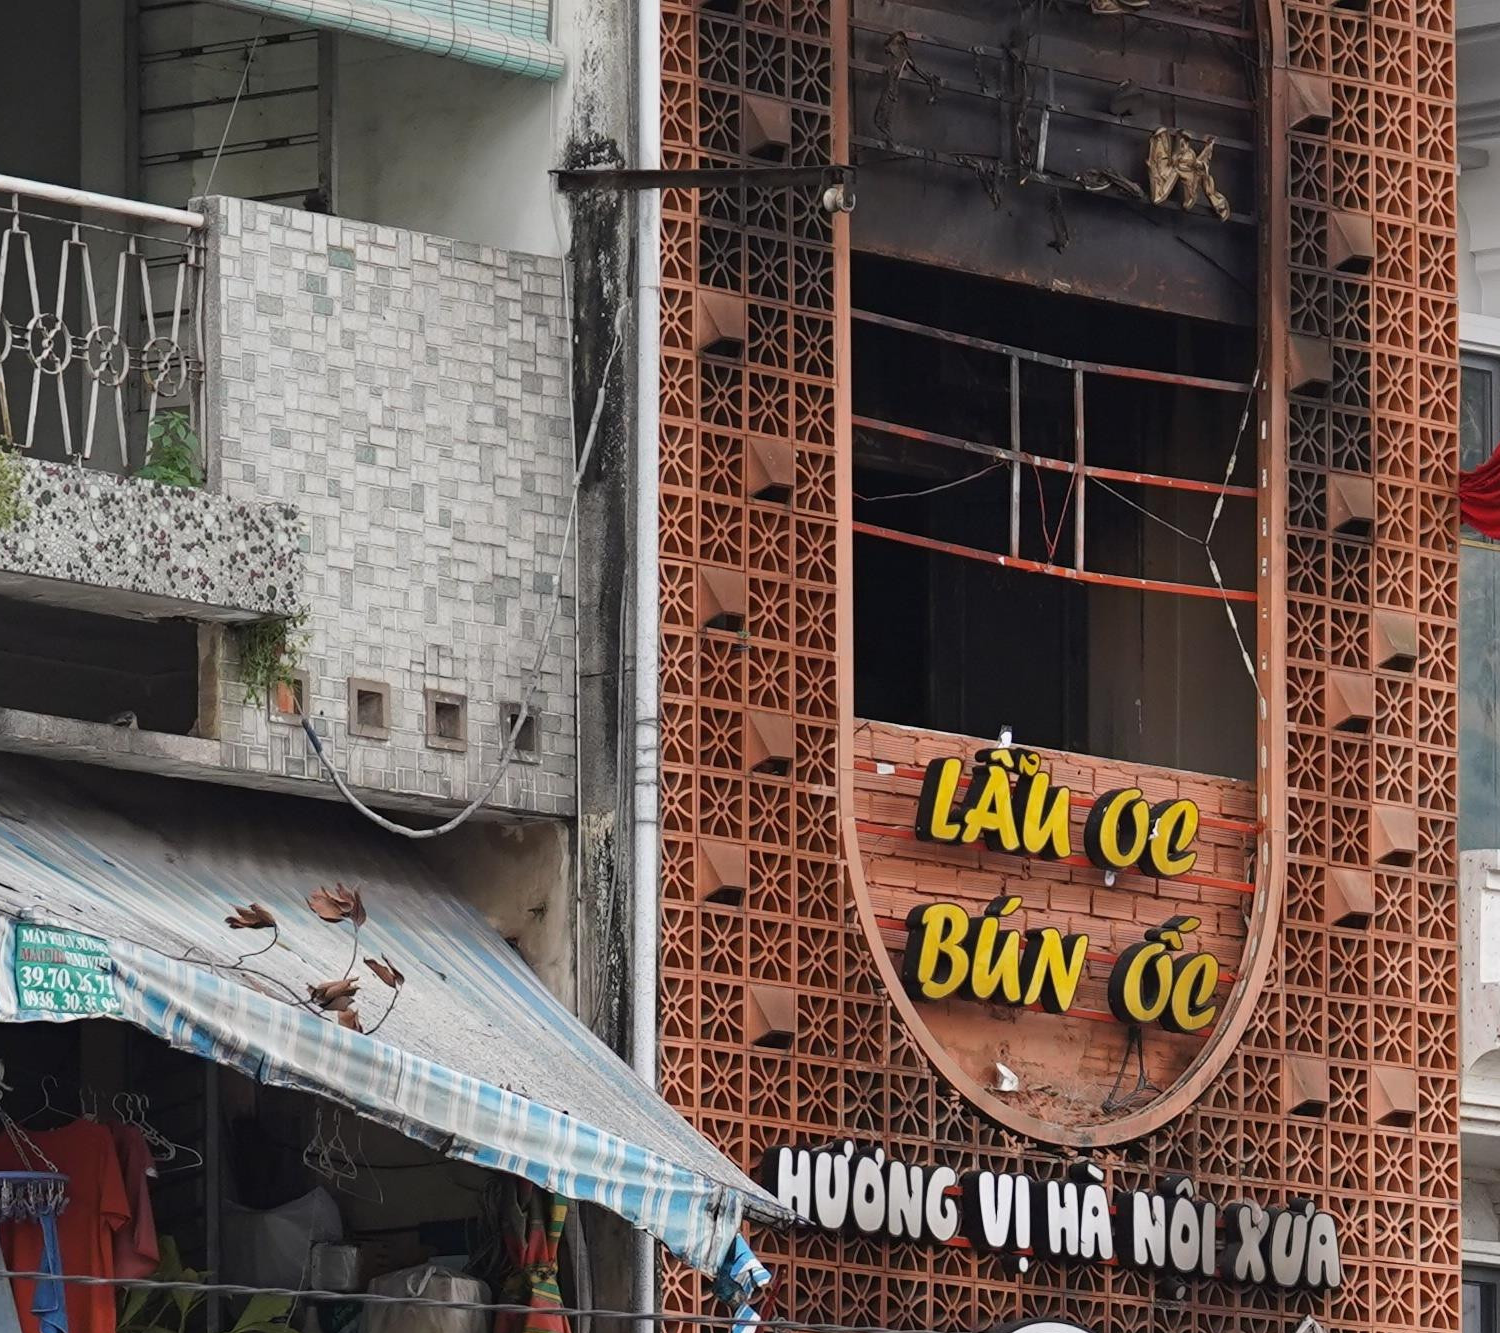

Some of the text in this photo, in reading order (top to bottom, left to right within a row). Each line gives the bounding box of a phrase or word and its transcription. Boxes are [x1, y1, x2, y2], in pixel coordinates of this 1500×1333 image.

[910, 896, 1218, 1032] BÚN ỐC
[774, 1140, 958, 1243] HƯƠNG
[979, 1171, 1031, 1272] VỊ
[1048, 1164, 1114, 1258] HÀ
[1235, 1198, 1342, 1289] XƯA
